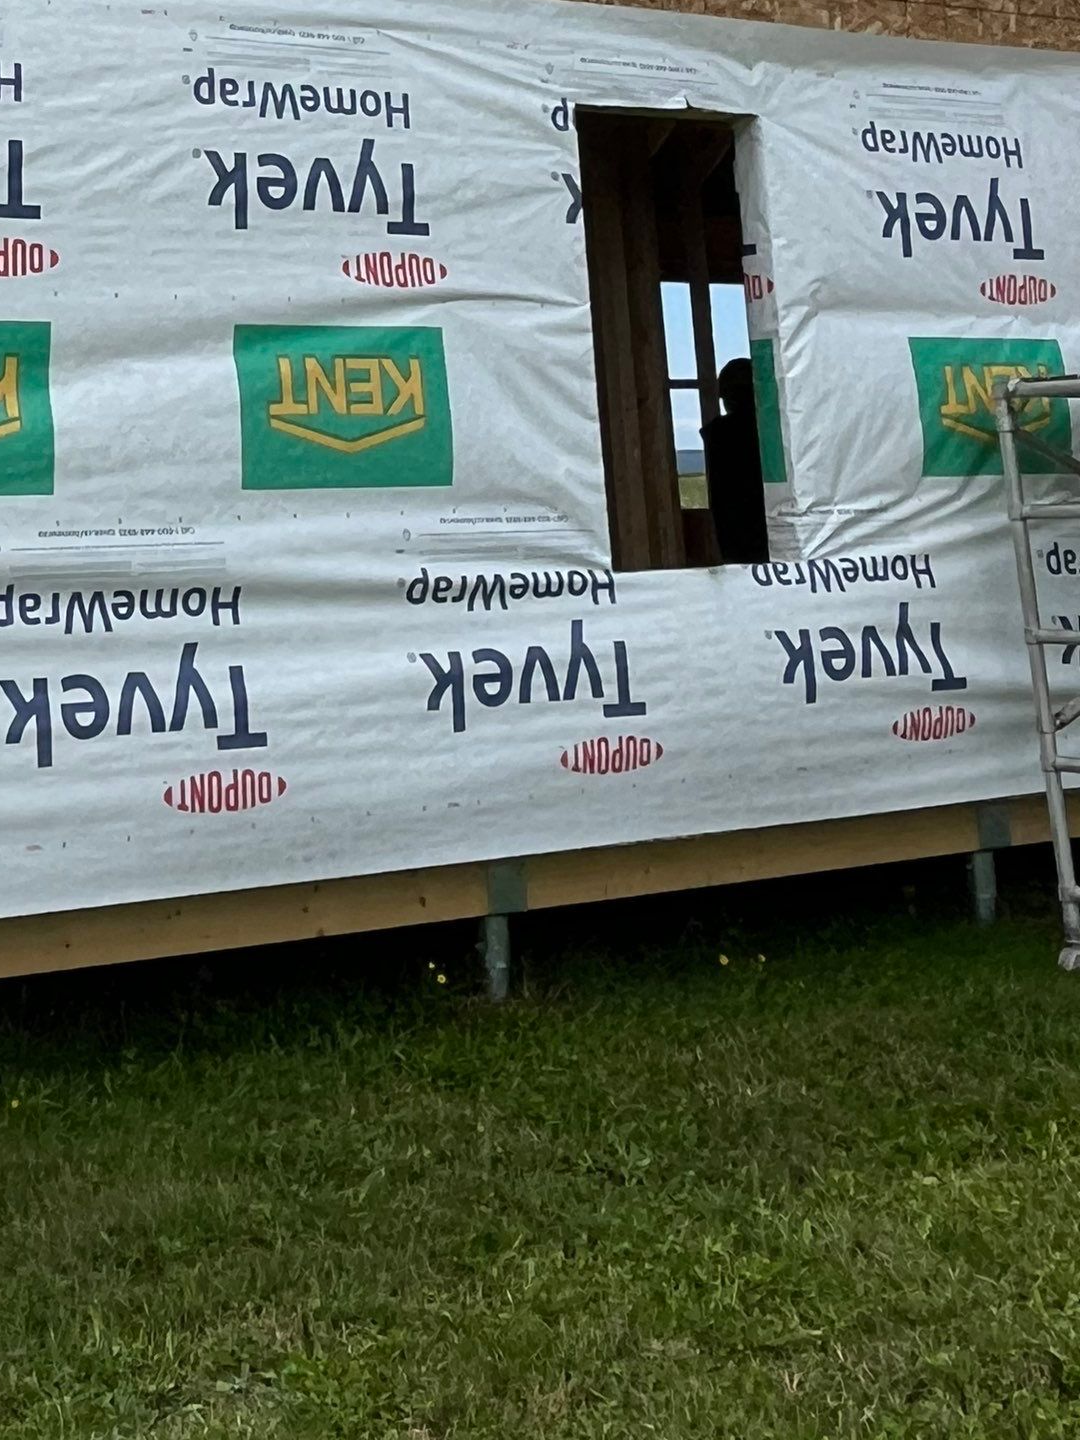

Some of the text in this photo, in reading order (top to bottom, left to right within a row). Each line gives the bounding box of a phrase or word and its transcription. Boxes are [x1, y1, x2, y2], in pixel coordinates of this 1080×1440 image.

[194, 68, 410, 129] HomeWrap
[862, 121, 1022, 168] HomeWrap
[204, 139, 429, 236] Tyvek
[876, 177, 1045, 260] Tyvek
[354, 252, 434, 288] DUPONT
[987, 274, 1047, 305] DUPONT
[269, 355, 424, 415] KENT
[406, 567, 617, 611] HomeWrap
[419, 620, 646, 732] Tyvek
[775, 602, 967, 704] Tyvek
[0, 642, 267, 768] Tyvek
[900, 706, 965, 741] DUPONT
[571, 735, 650, 774] DUPONT
[177, 769, 272, 813] DUPONT
